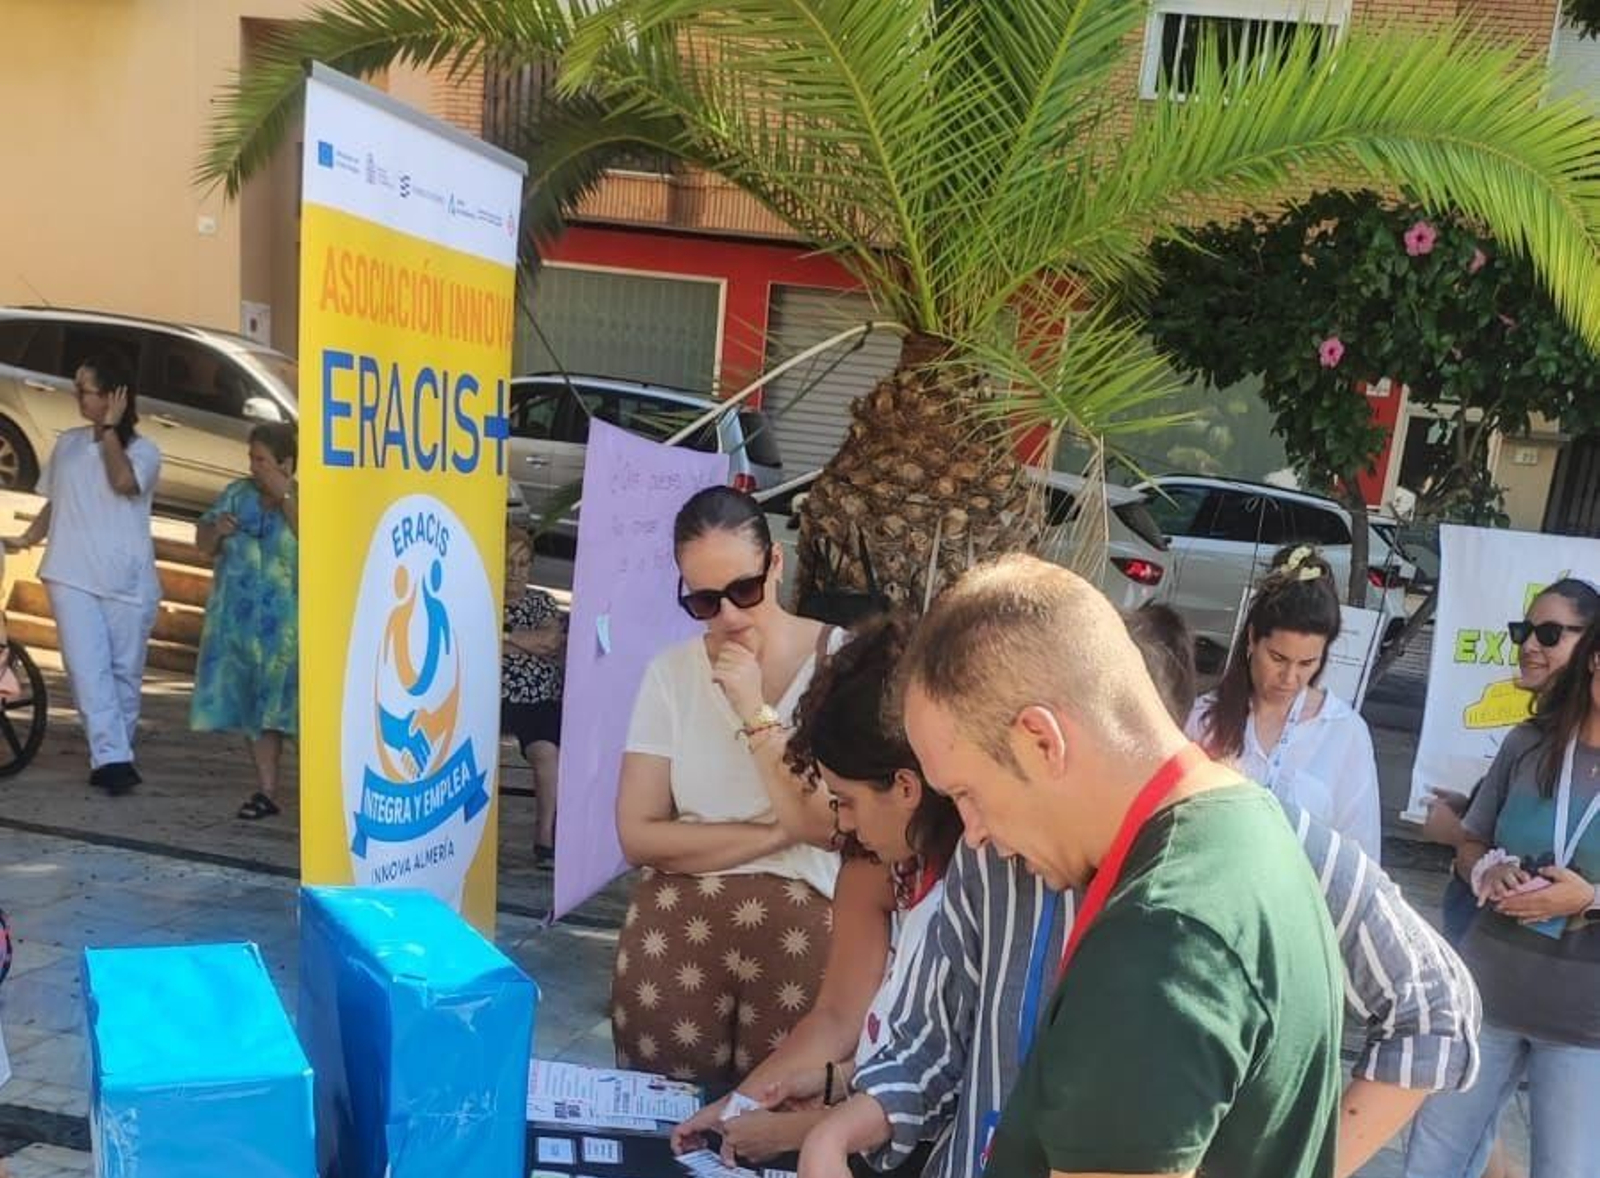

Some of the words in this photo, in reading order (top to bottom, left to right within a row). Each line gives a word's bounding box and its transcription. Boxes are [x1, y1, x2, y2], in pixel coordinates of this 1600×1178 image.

[320, 245, 444, 337] ASOCIACIÓN
[322, 348, 510, 477] ERACIS+
[392, 511, 449, 558] ERACIS
[364, 787, 412, 824] INTEGRA
[414, 794, 423, 820] Y
[424, 760, 471, 817] EMPLEA
[371, 857, 412, 884] INNOVA
[414, 834, 455, 868] ALMERÍA
